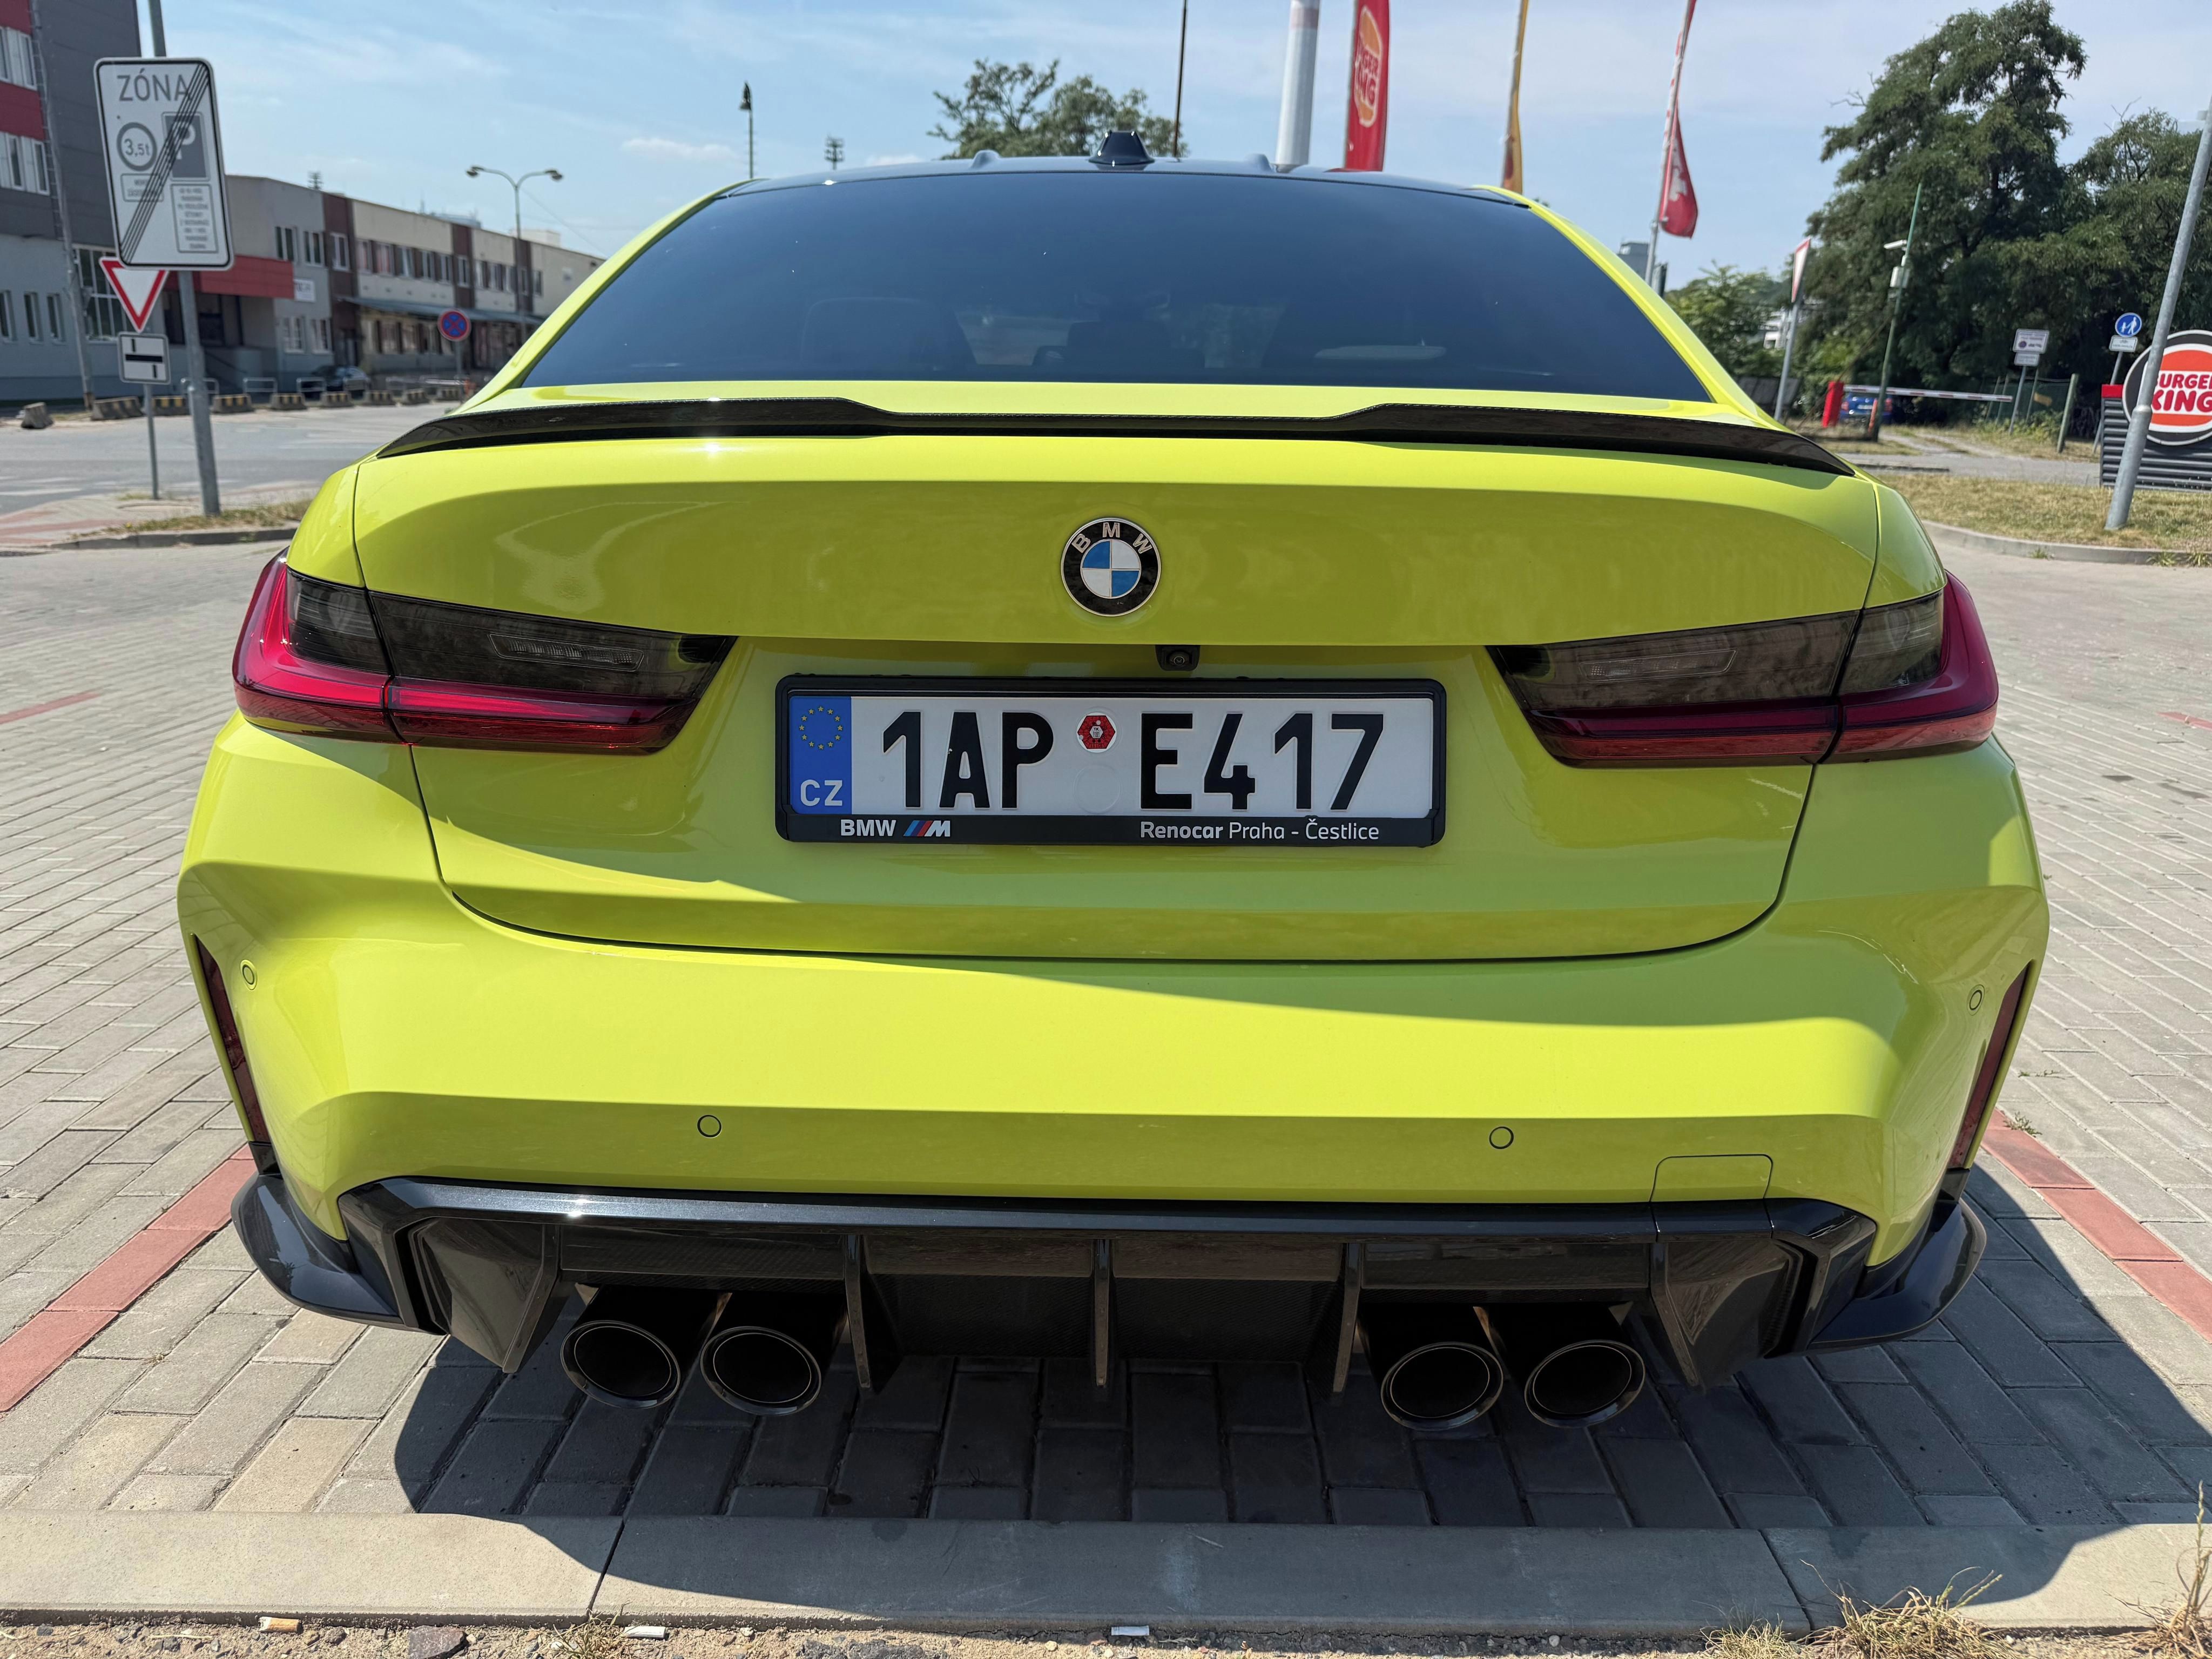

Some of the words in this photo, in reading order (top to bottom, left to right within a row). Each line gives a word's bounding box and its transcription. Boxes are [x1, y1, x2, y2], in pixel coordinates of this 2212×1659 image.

[117, 68, 192, 102] ZÓNA
[124, 138, 150, 157] 3,5t
[2156, 373, 2212, 389] URGE
[1071, 522, 1152, 554] BMW
[884, 711, 1054, 808] 1AP
[1141, 712, 1384, 810] E417
[800, 779, 842, 806] CZ
[841, 819, 896, 836] BMW
[1140, 821, 1223, 839] Renocar
[1229, 821, 1285, 840] Praha
[1305, 818, 1379, 840] Čestlice
